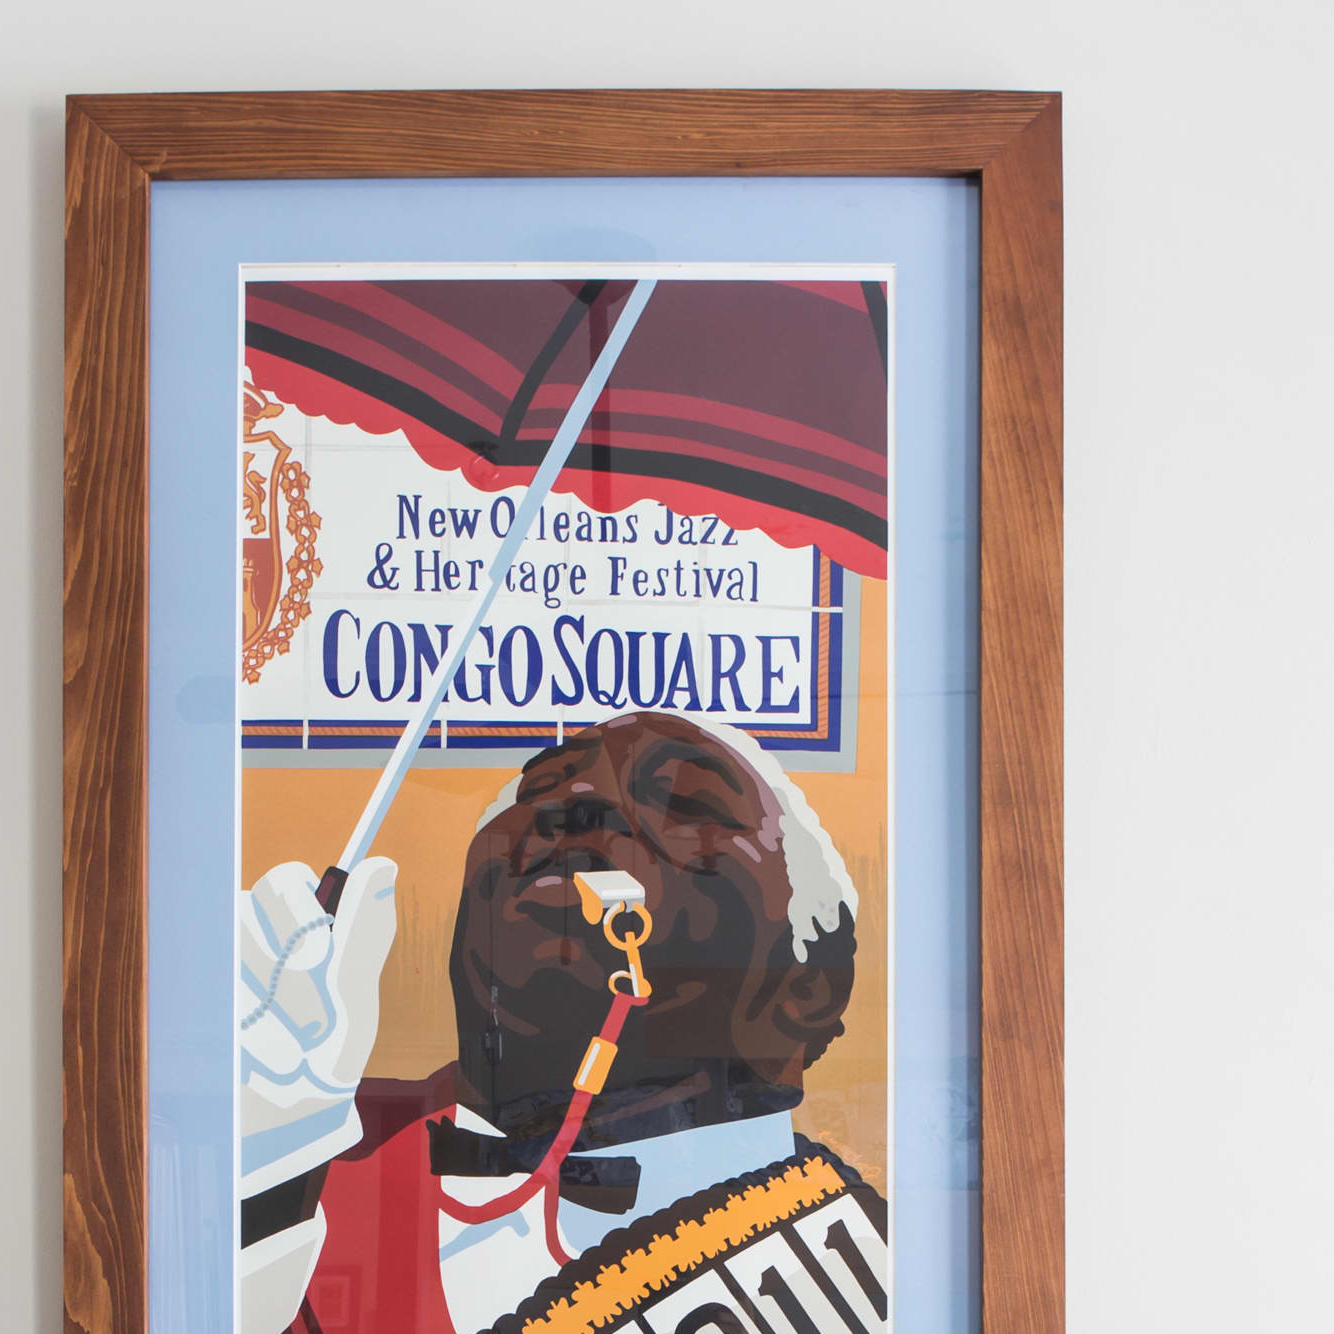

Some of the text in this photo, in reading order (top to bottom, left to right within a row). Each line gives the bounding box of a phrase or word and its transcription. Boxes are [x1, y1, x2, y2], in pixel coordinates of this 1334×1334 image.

[397, 494, 481, 539] New
[490, 496, 638, 544] Oleans
[368, 543, 399, 590] &
[607, 557, 759, 602] Festival
